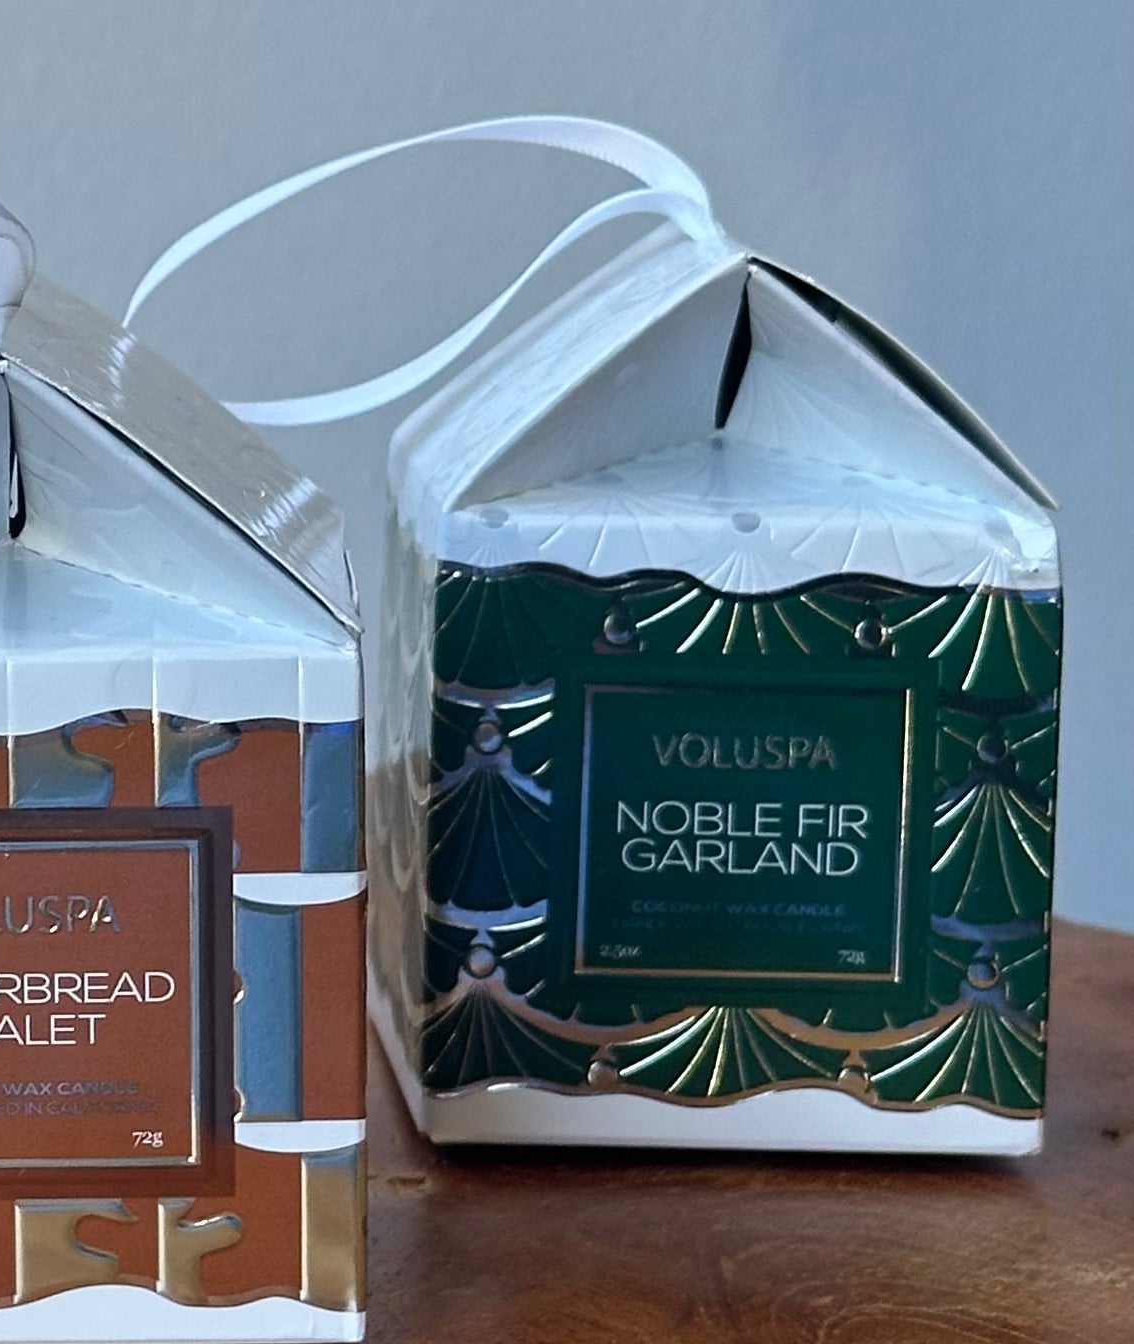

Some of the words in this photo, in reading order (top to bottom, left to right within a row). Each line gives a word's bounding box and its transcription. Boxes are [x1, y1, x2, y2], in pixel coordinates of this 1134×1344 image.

[653, 732, 837, 770] VOLUSPA
[617, 800, 782, 837] NOBLE
[798, 803, 868, 839] FIR
[622, 837, 859, 876] GARLAND
[726, 903, 770, 916] WAX
[773, 903, 846, 917] CANDLE
[2, 1082, 53, 1096] WAX
[58, 1081, 139, 1096] CANDLE
[24, 1101, 42, 1115] IN
[132, 1131, 163, 1148] 72g
